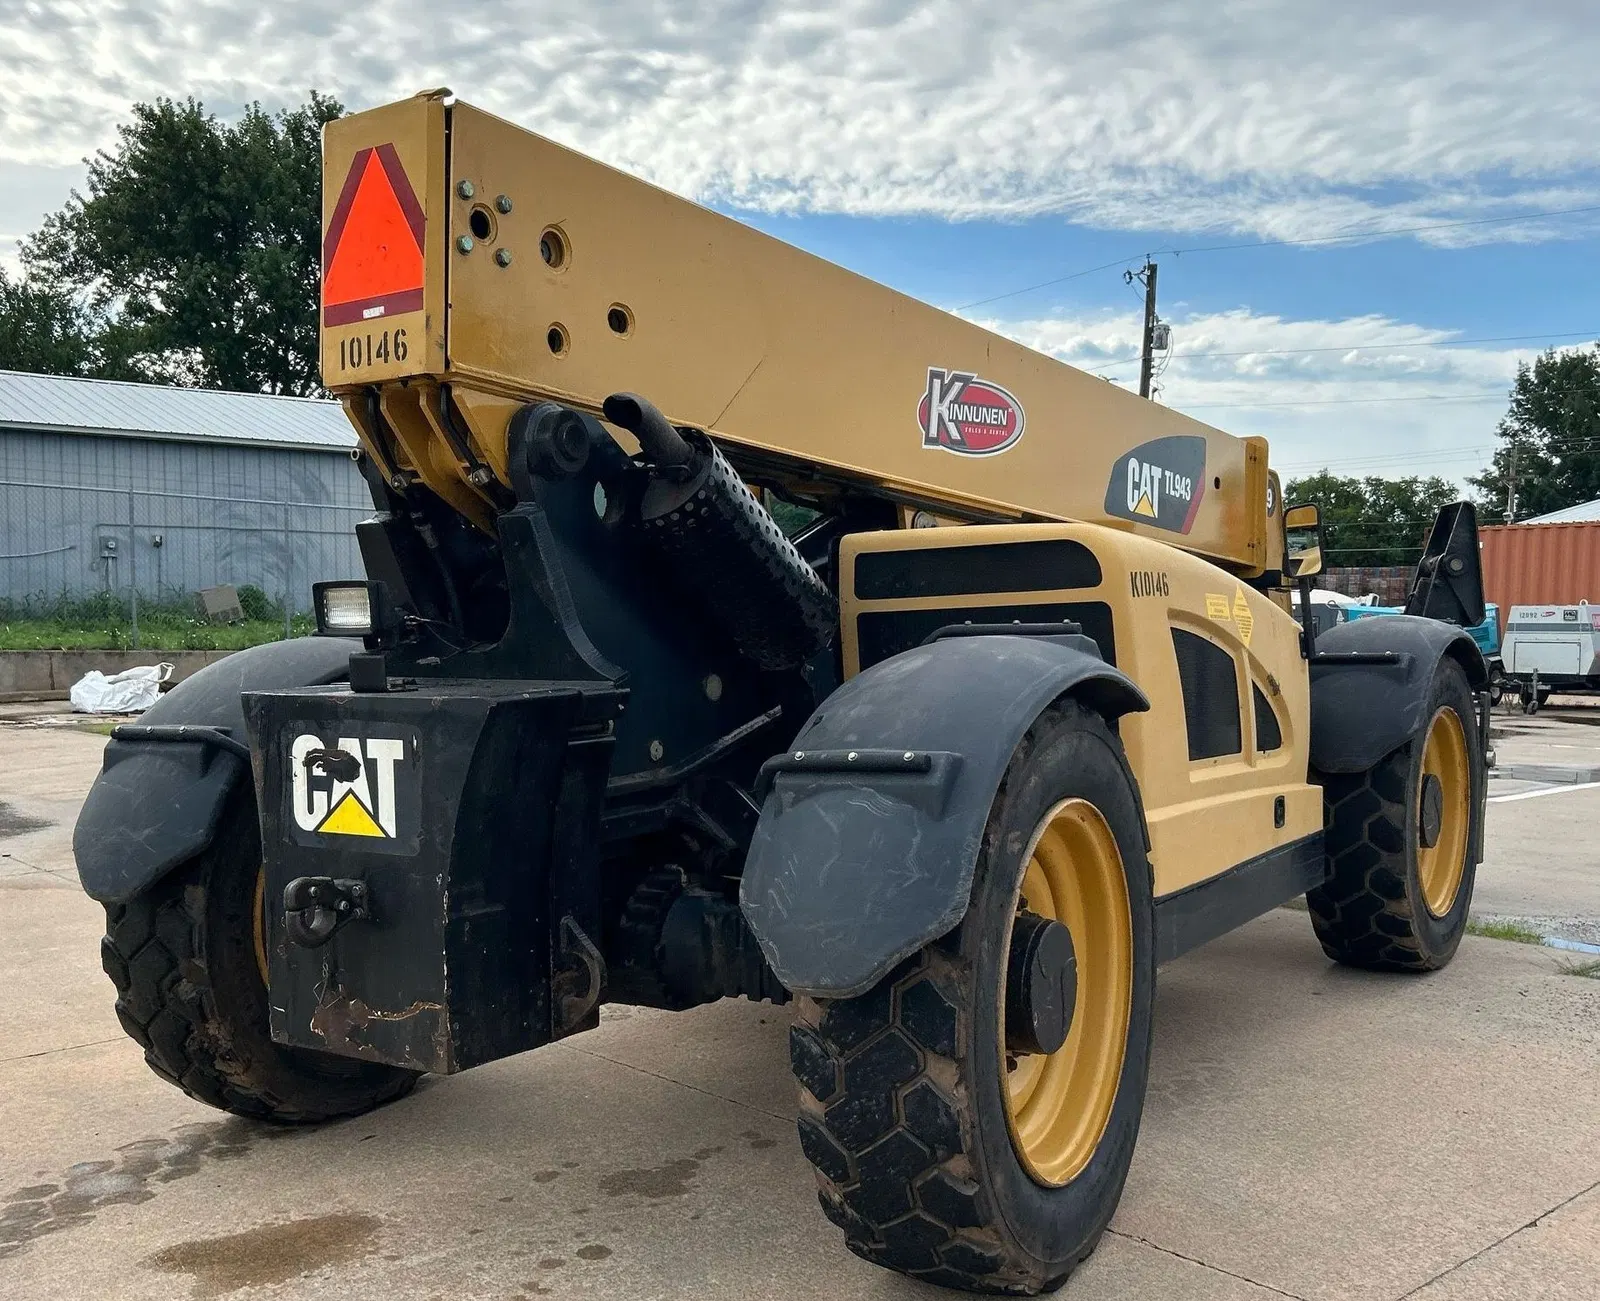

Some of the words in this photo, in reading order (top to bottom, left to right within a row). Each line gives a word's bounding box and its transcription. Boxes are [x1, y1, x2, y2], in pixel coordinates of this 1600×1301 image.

[340, 328, 408, 371] 10146
[926, 373, 1008, 443] KINNUNEN
[1126, 457, 1163, 519] CAT
[1164, 469, 1191, 501] TL943
[1130, 571, 1170, 598] K10146
[290, 733, 404, 839] CAT
